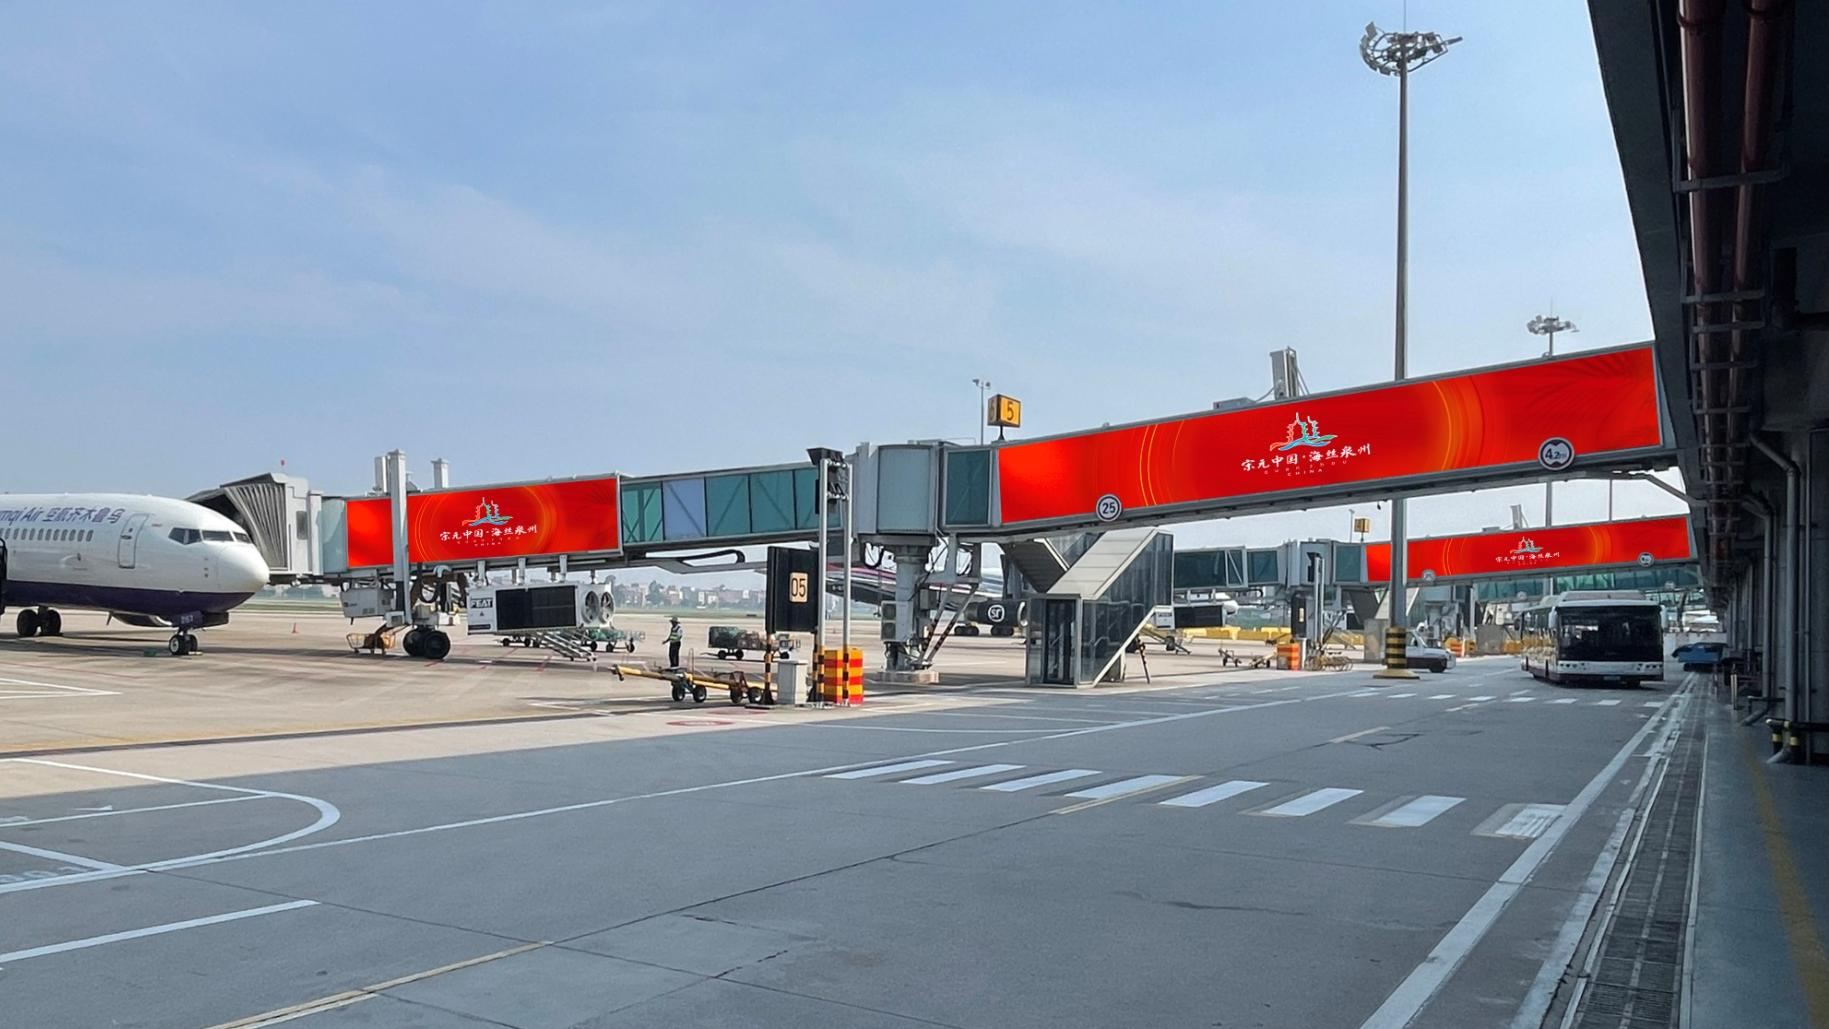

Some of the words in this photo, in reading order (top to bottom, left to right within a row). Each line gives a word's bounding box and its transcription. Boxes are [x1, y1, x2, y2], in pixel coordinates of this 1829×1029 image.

[1007, 400, 1014, 421] 5
[1102, 502, 1116, 514] 25
[791, 577, 806, 597] 05
